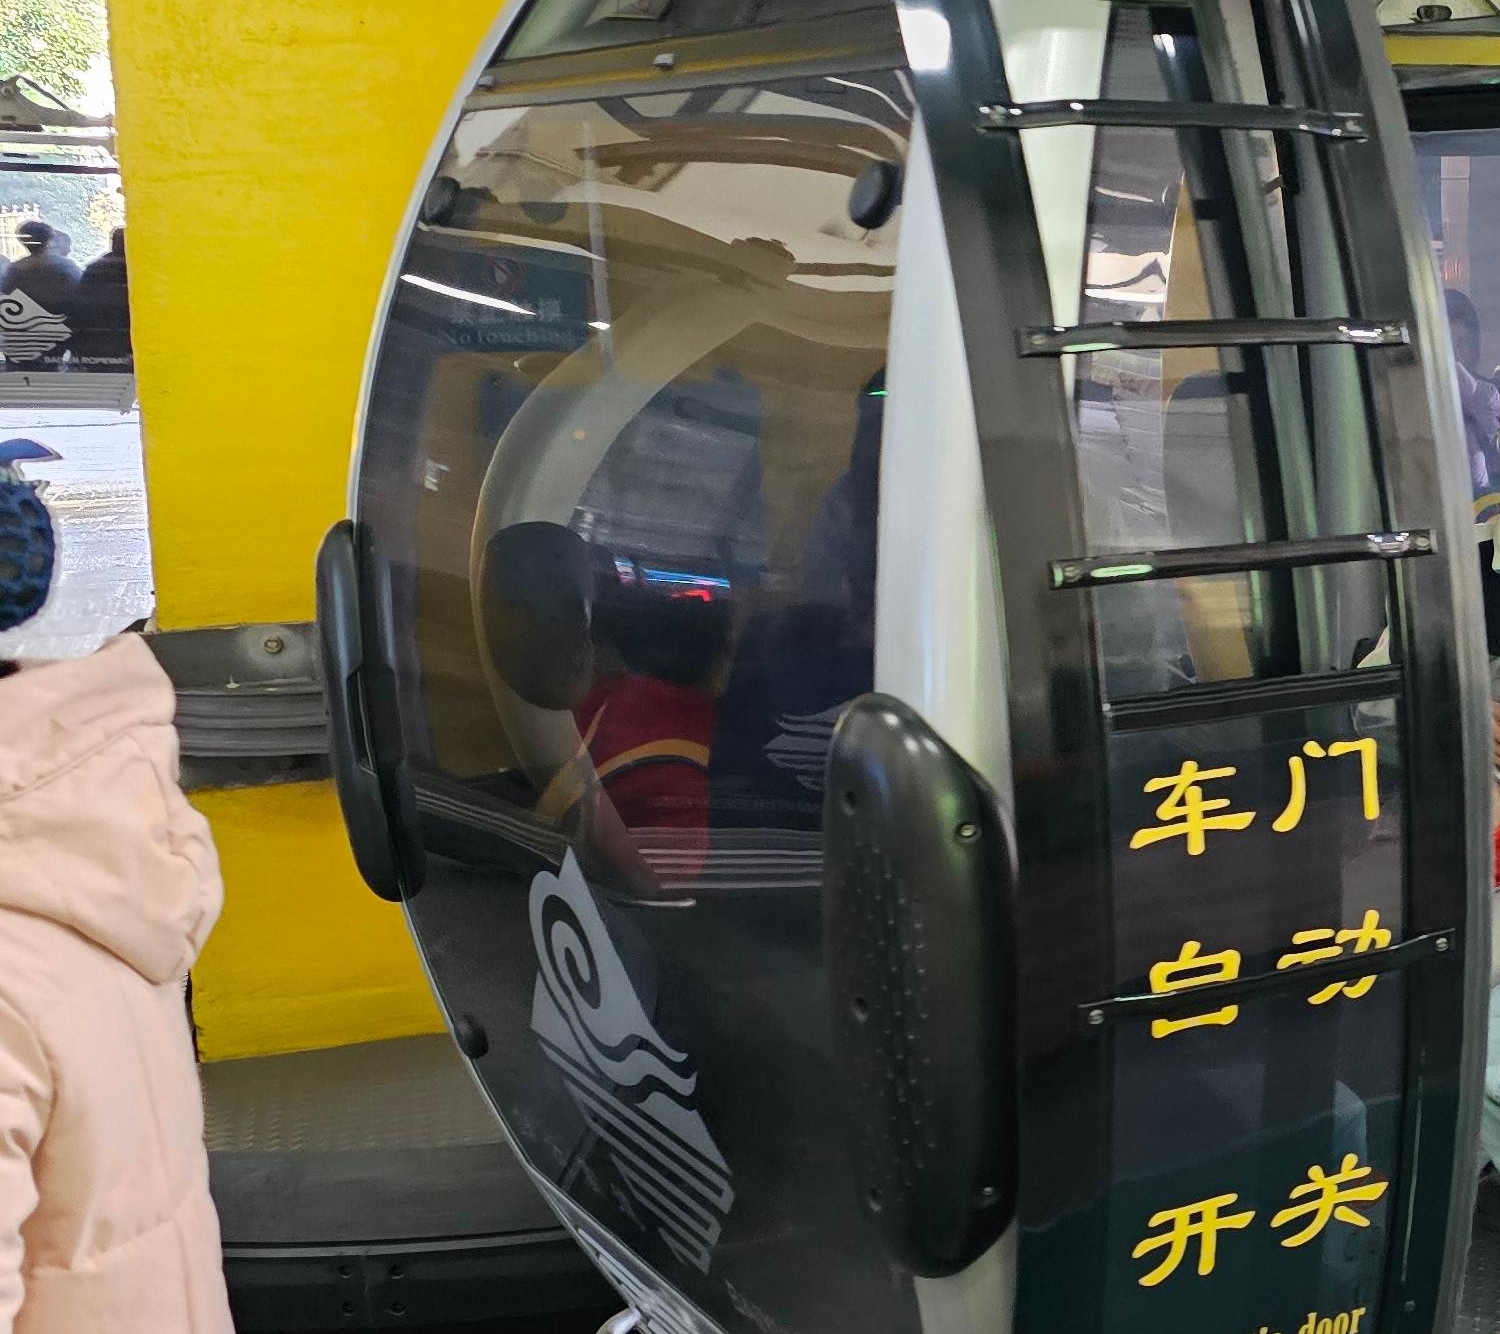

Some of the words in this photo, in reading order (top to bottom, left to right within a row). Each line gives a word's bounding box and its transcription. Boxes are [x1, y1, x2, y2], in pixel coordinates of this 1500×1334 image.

[1129, 737, 1381, 856] 车门
[1148, 909, 1392, 1040] 自动
[1131, 1152, 1390, 1287] 开关
